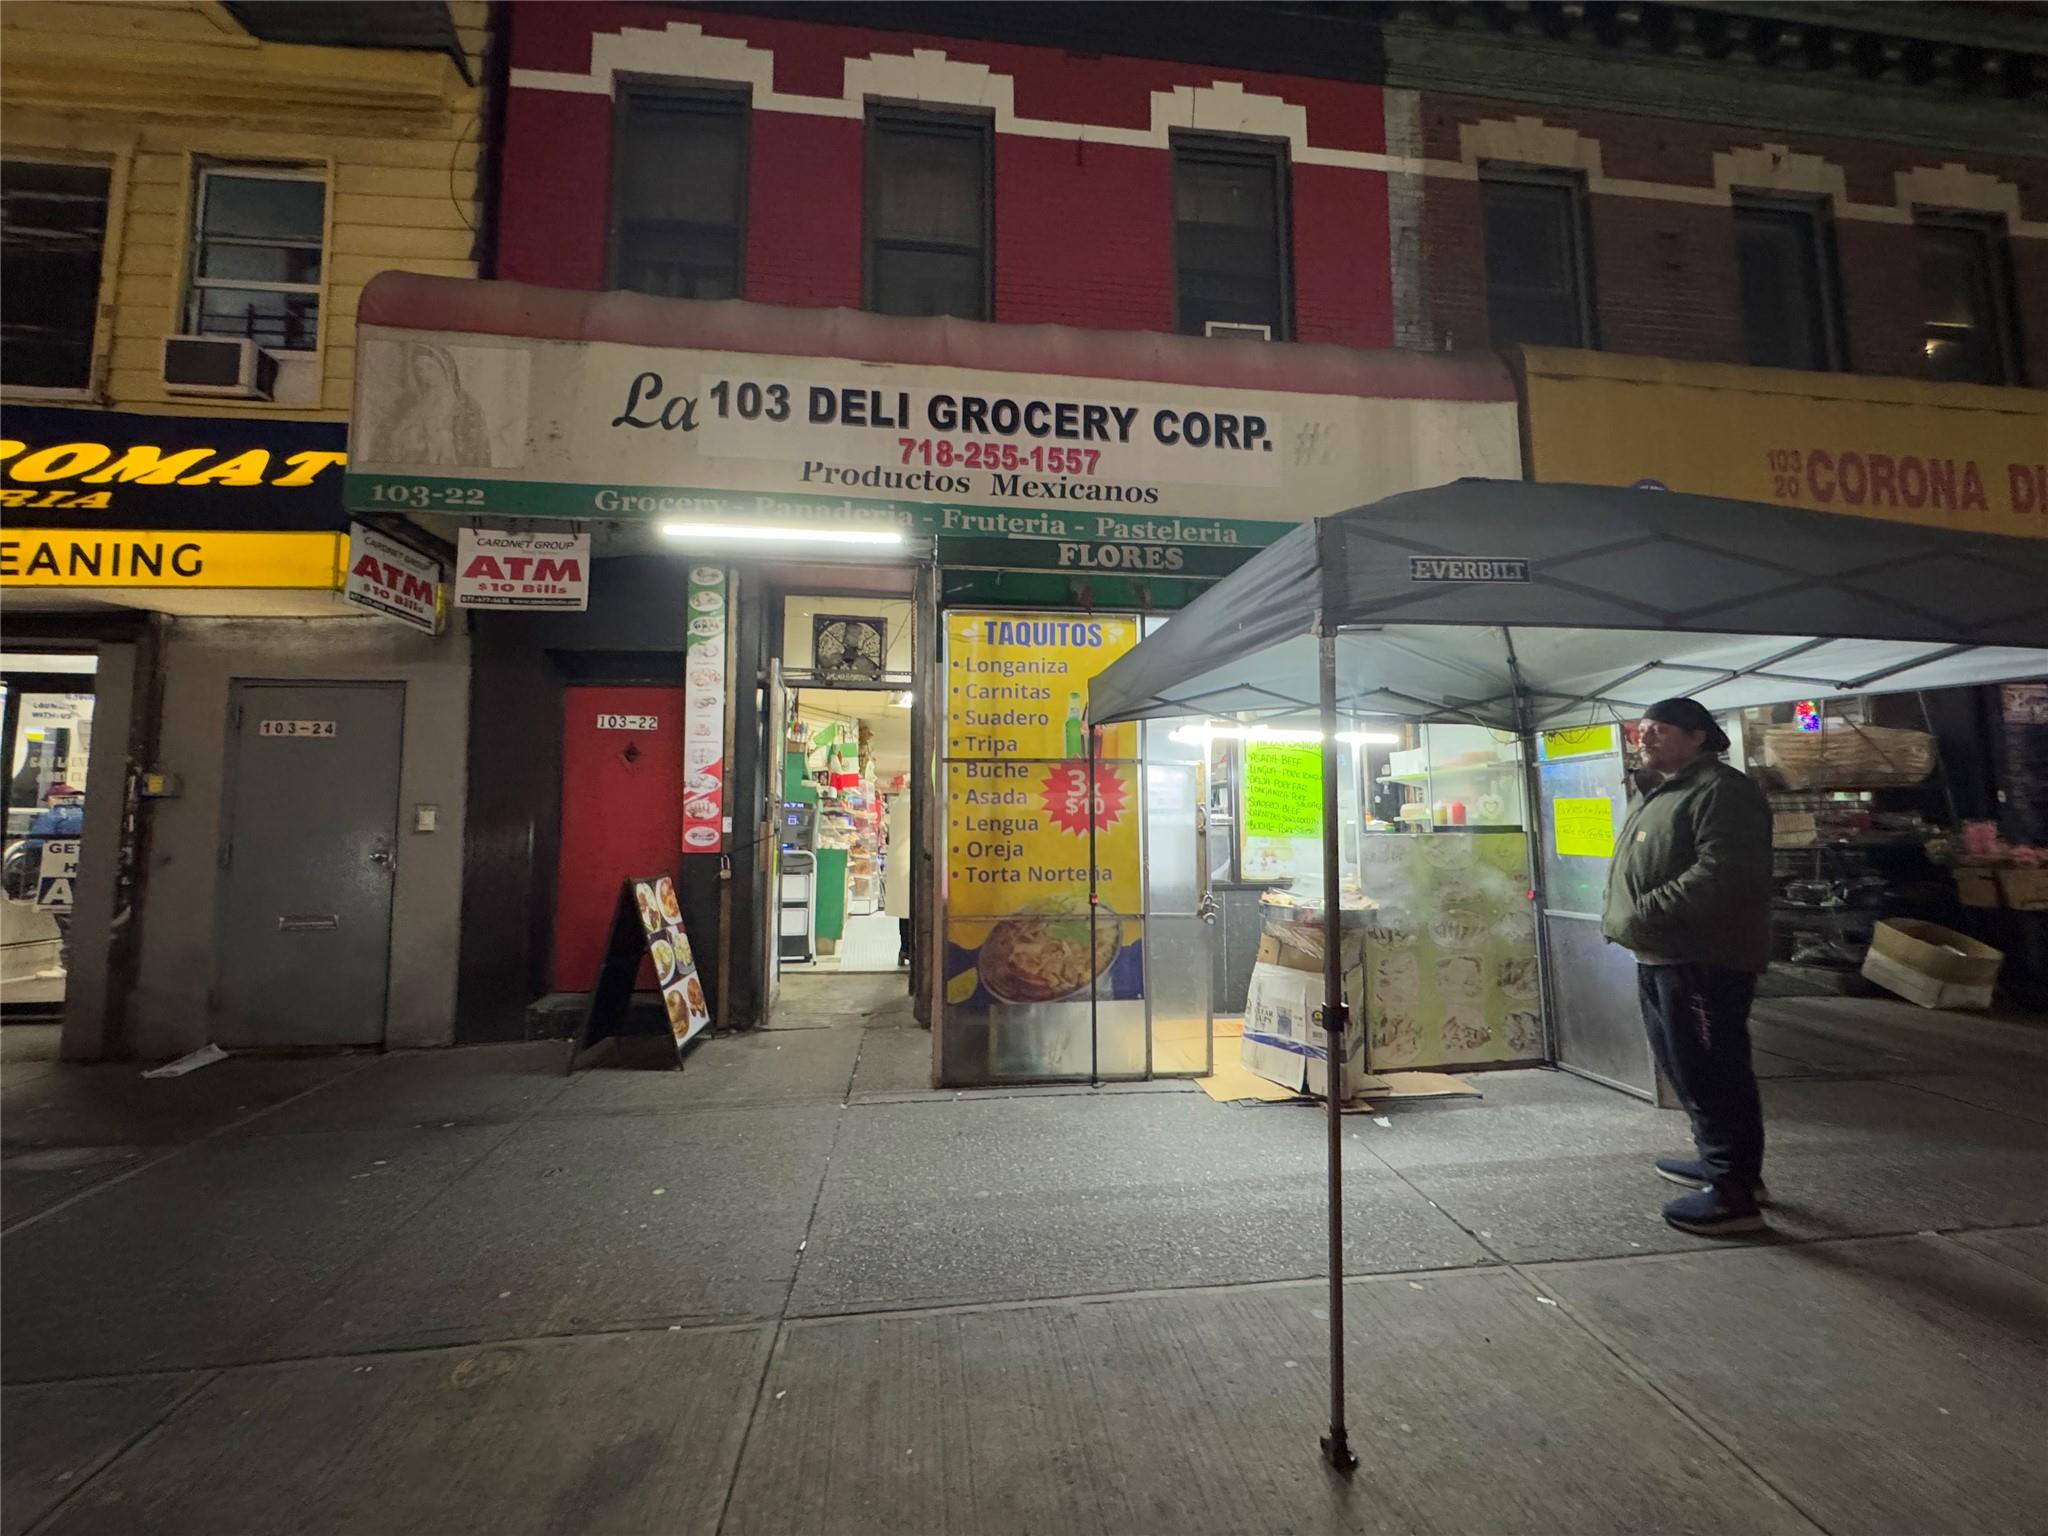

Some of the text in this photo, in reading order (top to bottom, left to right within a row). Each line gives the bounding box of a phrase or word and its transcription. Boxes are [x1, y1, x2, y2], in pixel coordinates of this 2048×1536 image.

[613, 372, 700, 433] La
[710, 381, 1273, 452] 103 DELI GROCERY CORP.
[899, 438, 1101, 475] 718-255-1557
[800, 462, 1160, 505] Productos Mexicanos
[1806, 449, 1989, 511] CORONA
[371, 484, 485, 507] 103-22
[594, 489, 729, 516] Grocery
[942, 508, 1066, 535] Fruteria
[1096, 516, 1238, 543] Pasteleria
[534, 541, 575, 550] GROUP
[1058, 542, 1184, 570] FLORES
[462, 555, 583, 582] ATM
[1415, 560, 1525, 579] EVERBILT
[352, 554, 433, 606] ATM
[478, 582, 568, 594] $10 Bills
[984, 621, 1102, 647] TAQUITOS
[966, 657, 1068, 677] Longaniza
[966, 683, 1051, 699] Carnitas
[600, 716, 656, 729] 103-22
[966, 709, 1049, 727] Suadero
[264, 723, 333, 734] 103-24
[966, 735, 1018, 756] Tripa
[966, 761, 1029, 779] Buche
[966, 788, 1028, 805] Asada
[966, 816, 1039, 834] Lengua
[967, 841, 1024, 861] Oreja
[966, 867, 1021, 883] Torta
